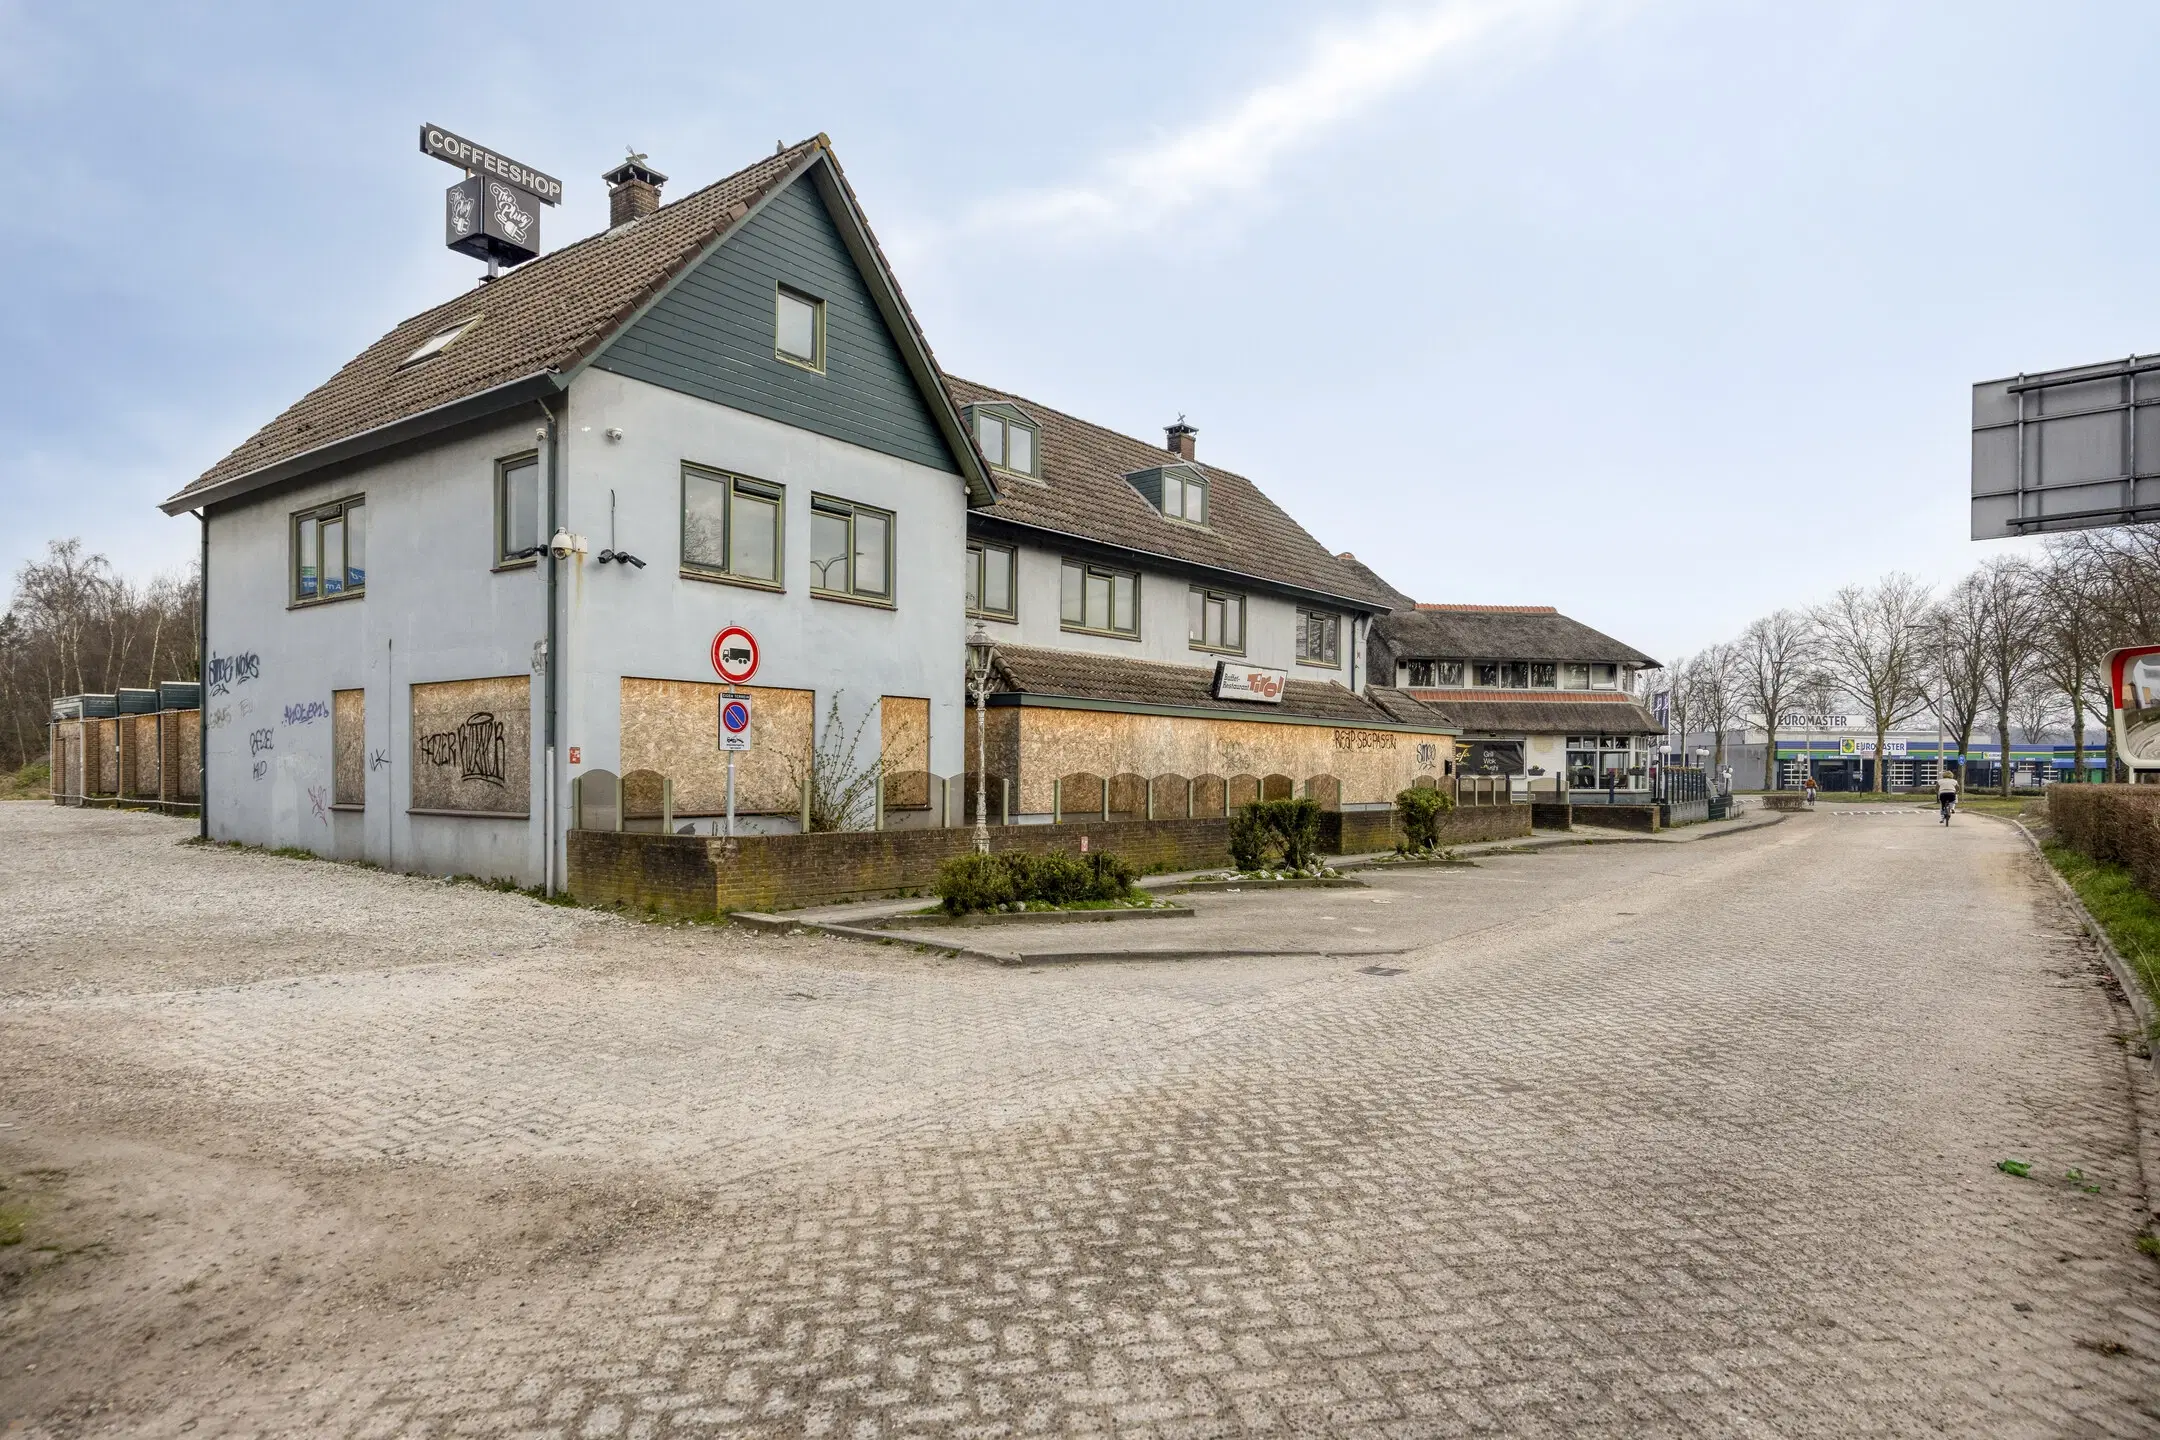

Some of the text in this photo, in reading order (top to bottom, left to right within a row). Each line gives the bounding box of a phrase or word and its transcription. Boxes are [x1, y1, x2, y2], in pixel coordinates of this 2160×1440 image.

[429, 130, 561, 197] COFFEESHOP
[492, 185, 514, 202] The
[498, 201, 532, 228] Plug
[1248, 672, 1285, 698] Tirol
[1778, 715, 1848, 726] EUROMASTER
[1856, 742, 1905, 751] EUROASTER
